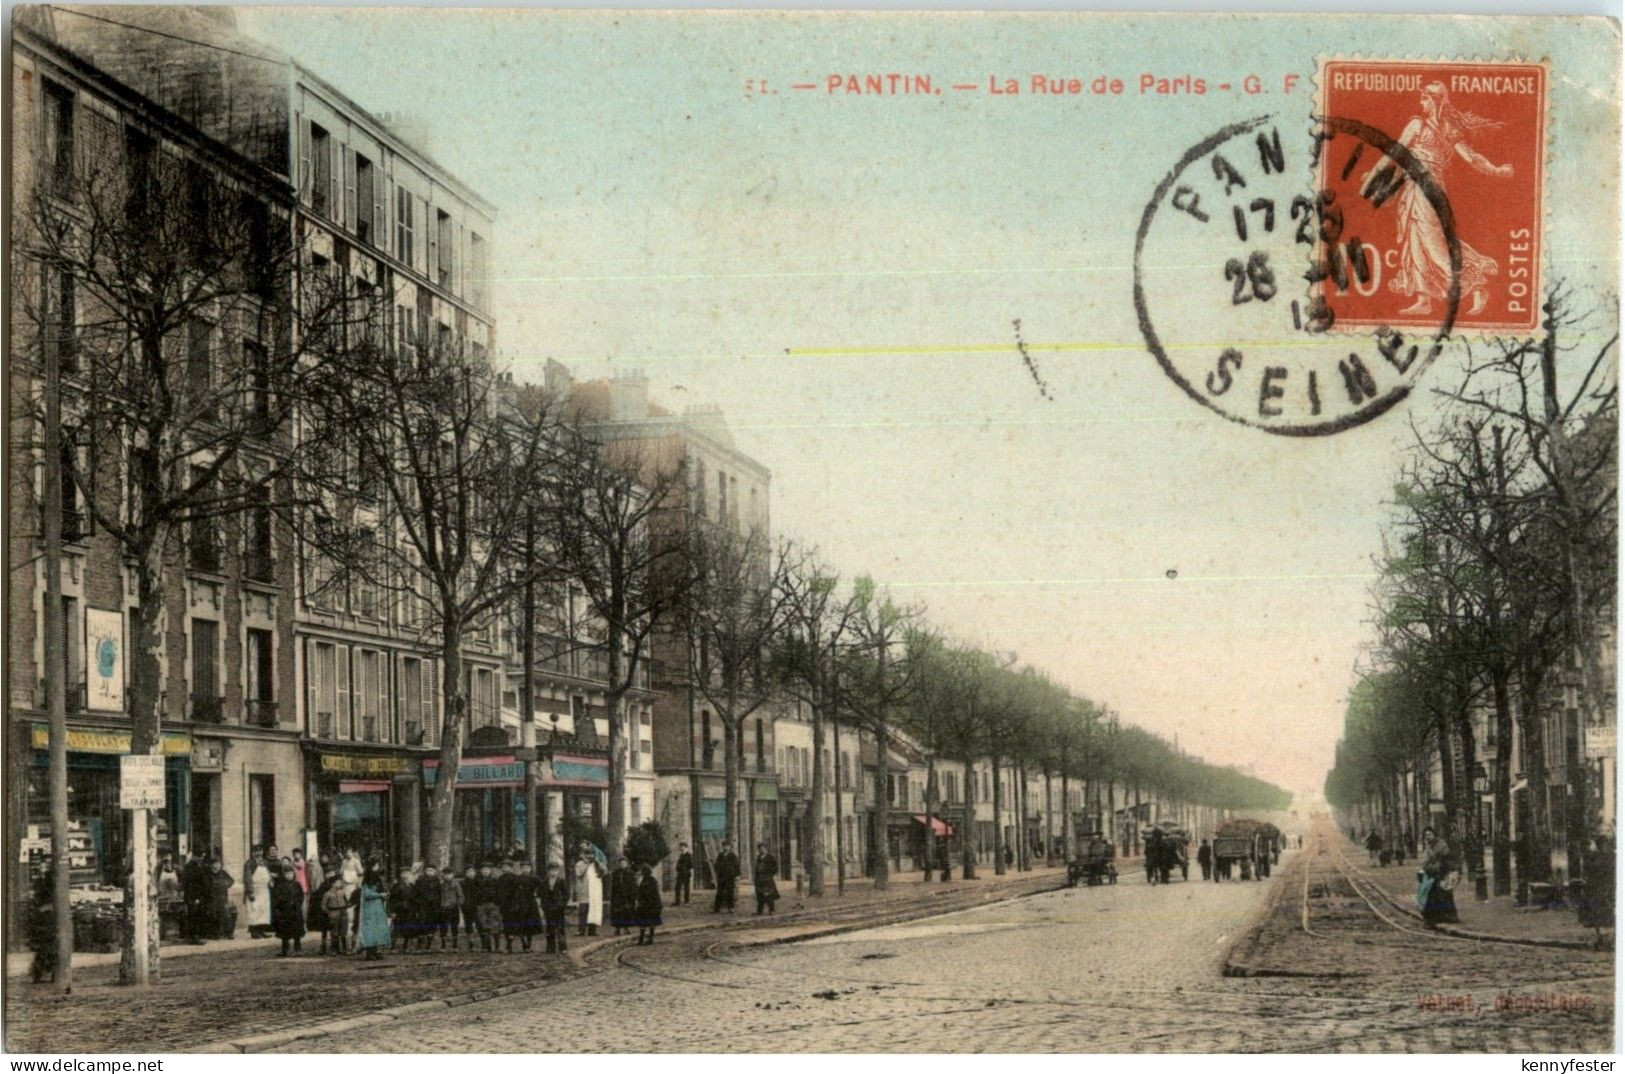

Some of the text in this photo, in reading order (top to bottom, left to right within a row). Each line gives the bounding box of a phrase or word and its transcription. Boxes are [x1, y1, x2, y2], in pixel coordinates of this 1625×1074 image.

[1334, 72, 1535, 95] REPUBLIQUE FRANÇAISE
[1508, 227, 1530, 312] POSTES
[1205, 329, 1419, 416] SEINE
[473, 764, 525, 780] BILLARD
